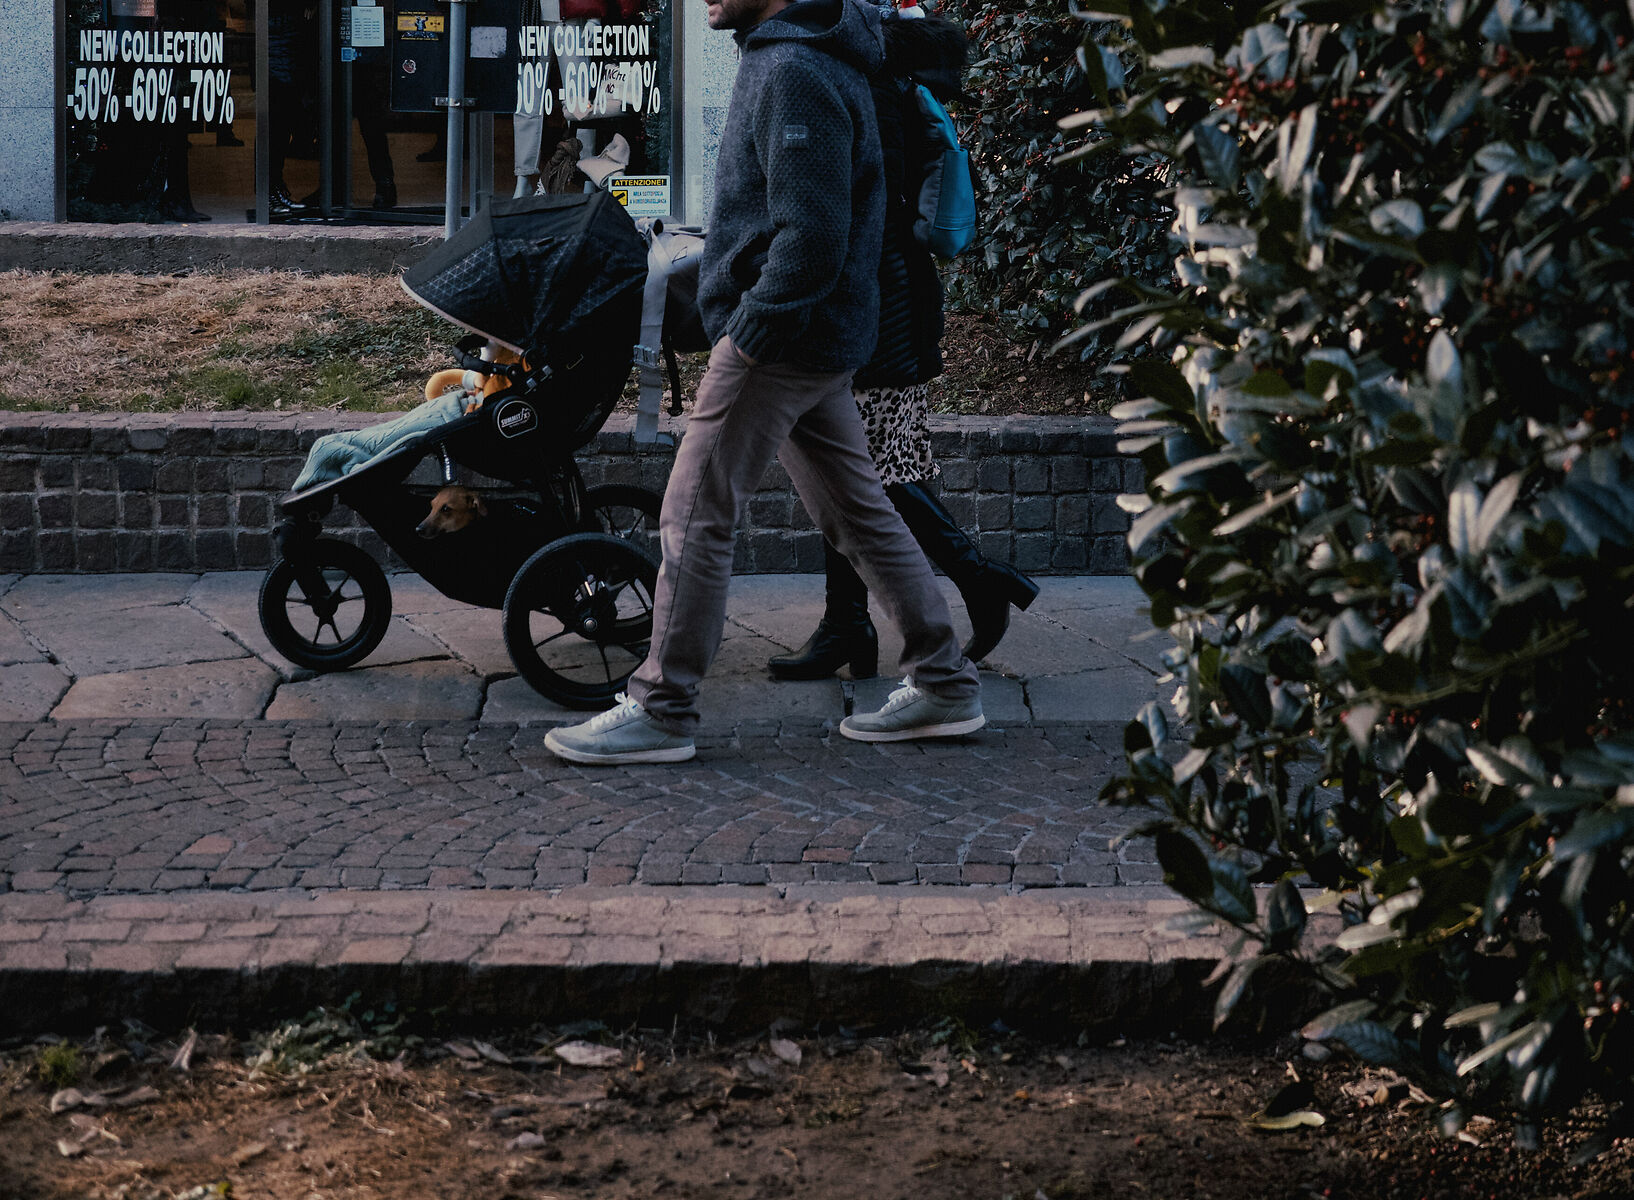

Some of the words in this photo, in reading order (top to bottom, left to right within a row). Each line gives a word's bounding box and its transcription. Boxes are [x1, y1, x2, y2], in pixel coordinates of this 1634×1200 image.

[79, 29, 118, 62] NEW
[121, 30, 224, 64] COLLECTION
[518, 25, 550, 57] NEW
[553, 24, 650, 57] COLLECTION
[66, 66, 119, 123] -50%
[124, 67, 177, 124] -60%
[182, 68, 235, 125] -70%
[558, 61, 607, 115] -60%
